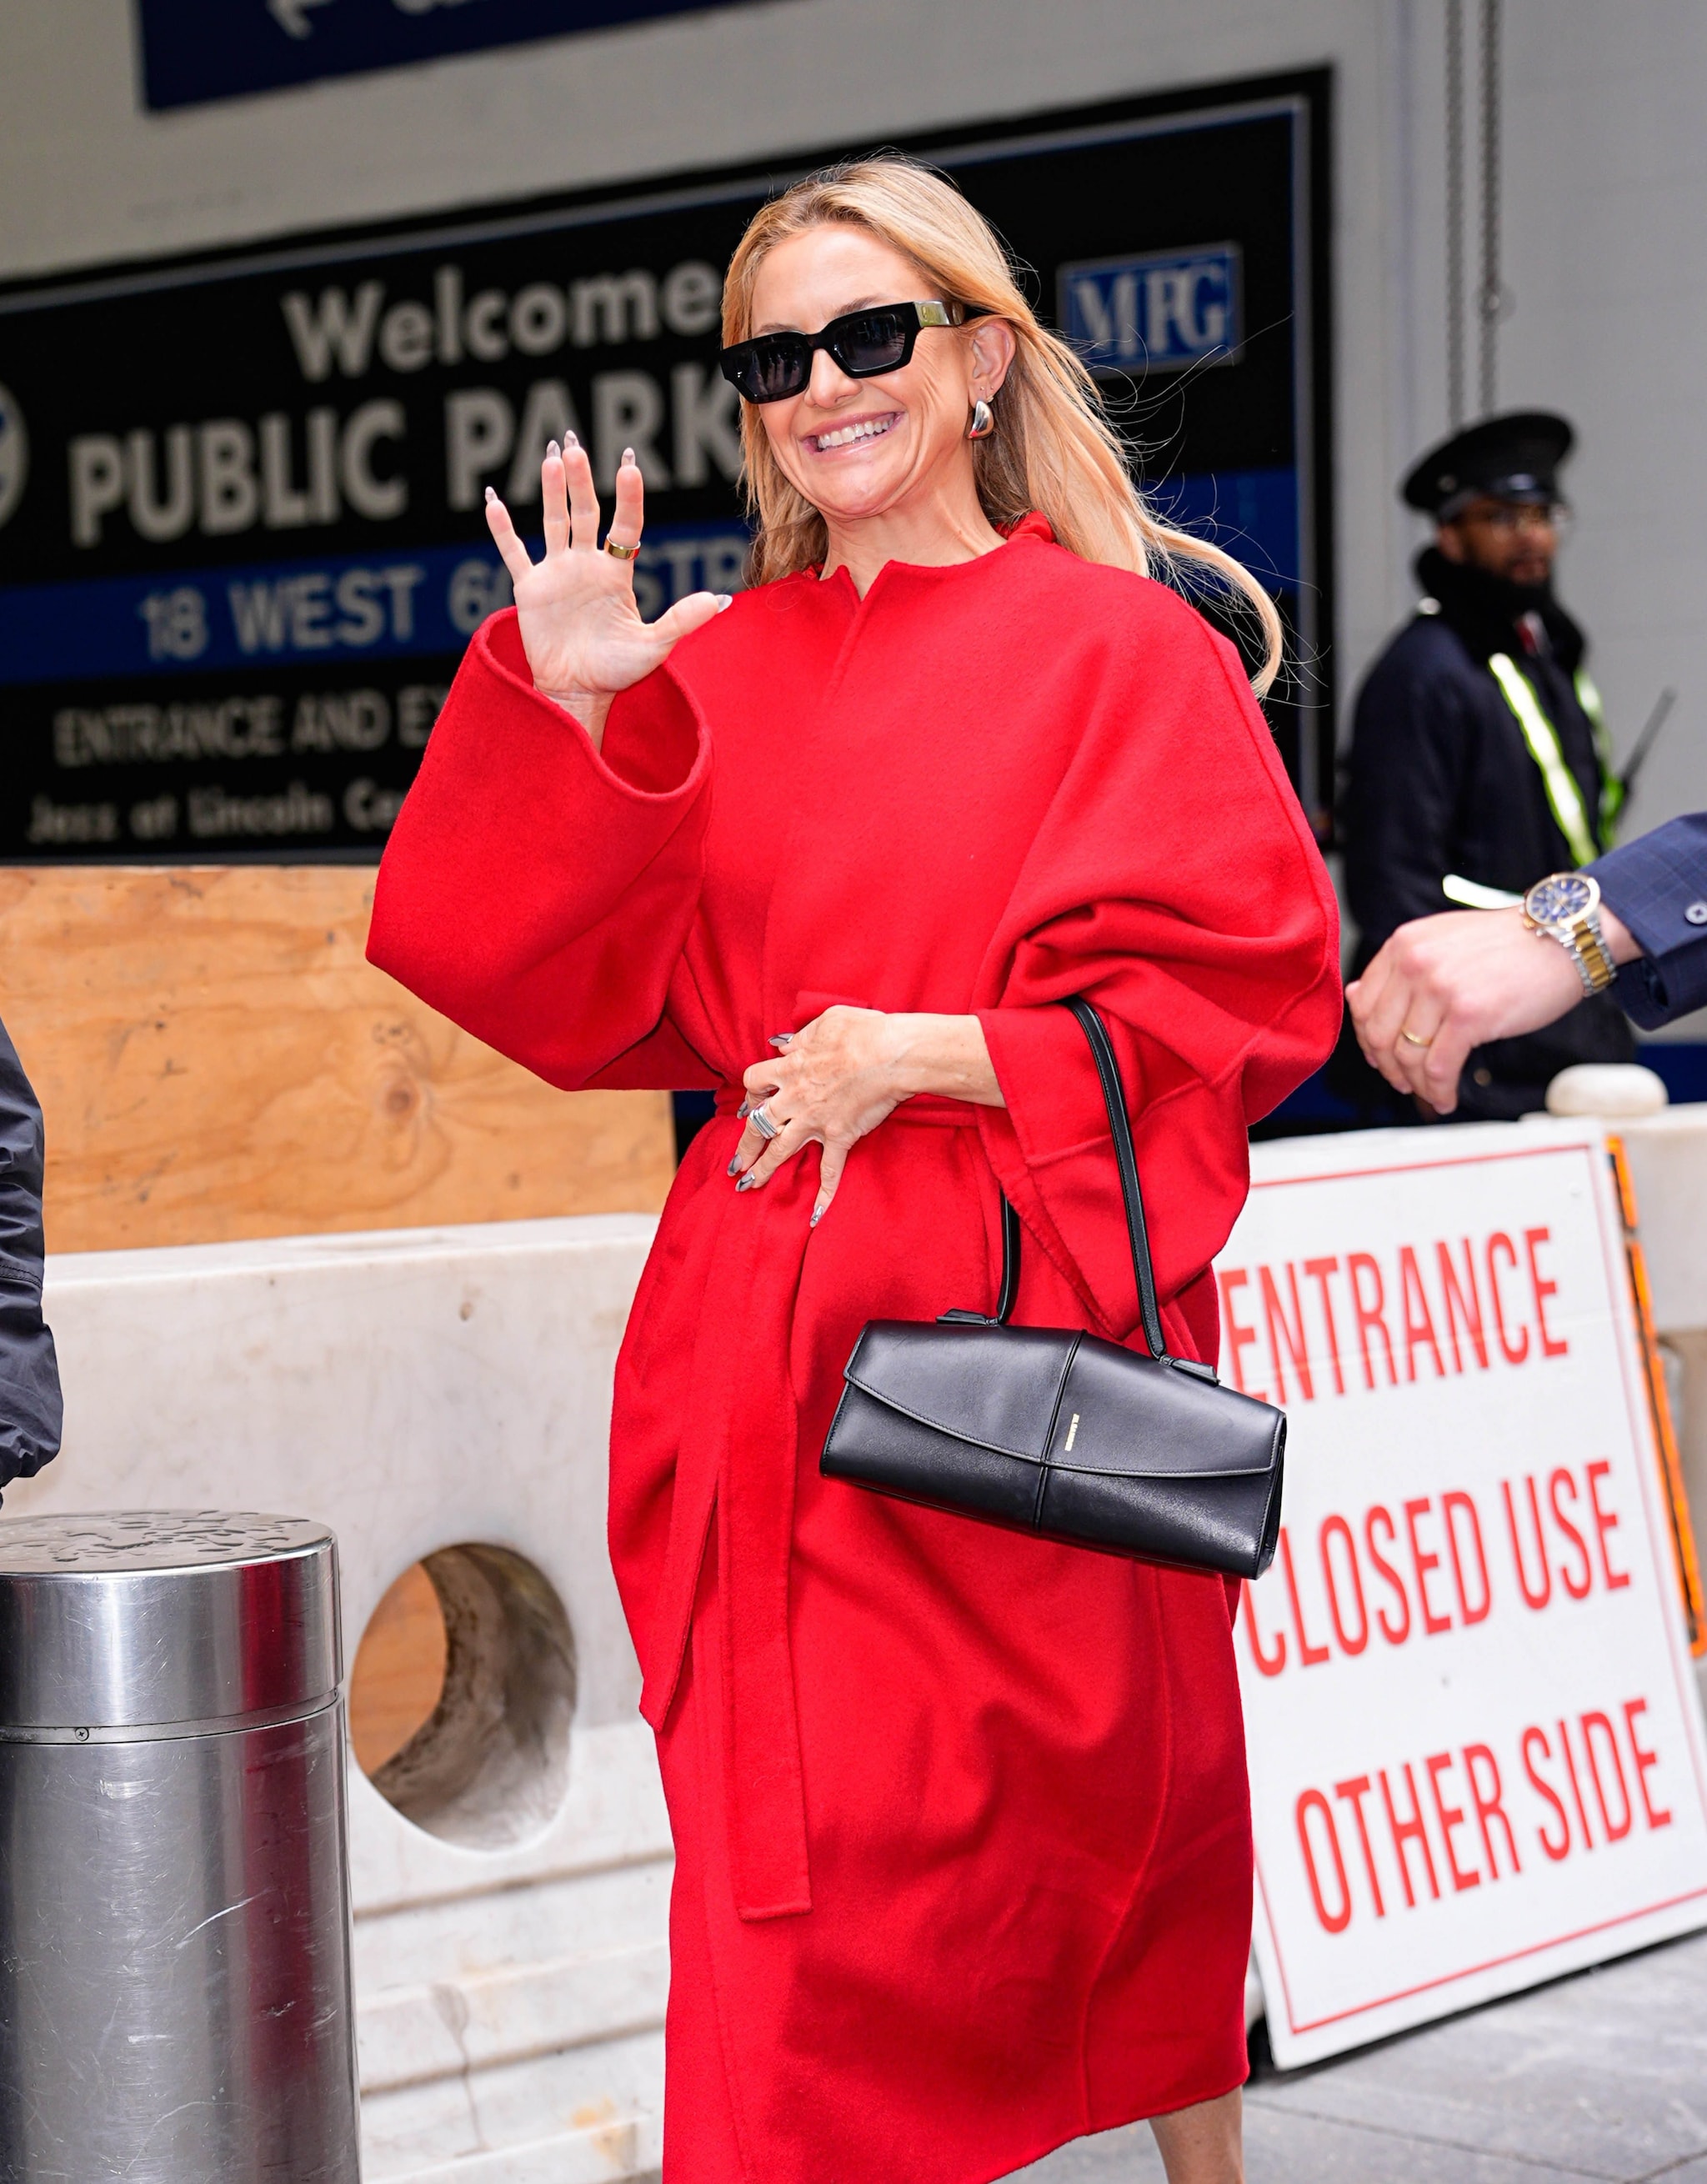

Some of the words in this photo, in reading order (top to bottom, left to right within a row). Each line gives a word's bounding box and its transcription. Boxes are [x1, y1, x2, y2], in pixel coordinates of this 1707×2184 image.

[282, 260, 722, 381] Welcome
[69, 398, 408, 547] PUBLIC
[138, 586, 208, 659] 18
[228, 564, 423, 654] WEST
[53, 695, 285, 767] ENTRANCE
[292, 690, 391, 749] AND
[1219, 1225, 1569, 1405] ENTRANCE
[1242, 1489, 1494, 1678] CLOSED
[1500, 1458, 1632, 1612] USE
[1294, 1741, 1522, 1935] OTHER
[1519, 1696, 1674, 1863] SIDE
